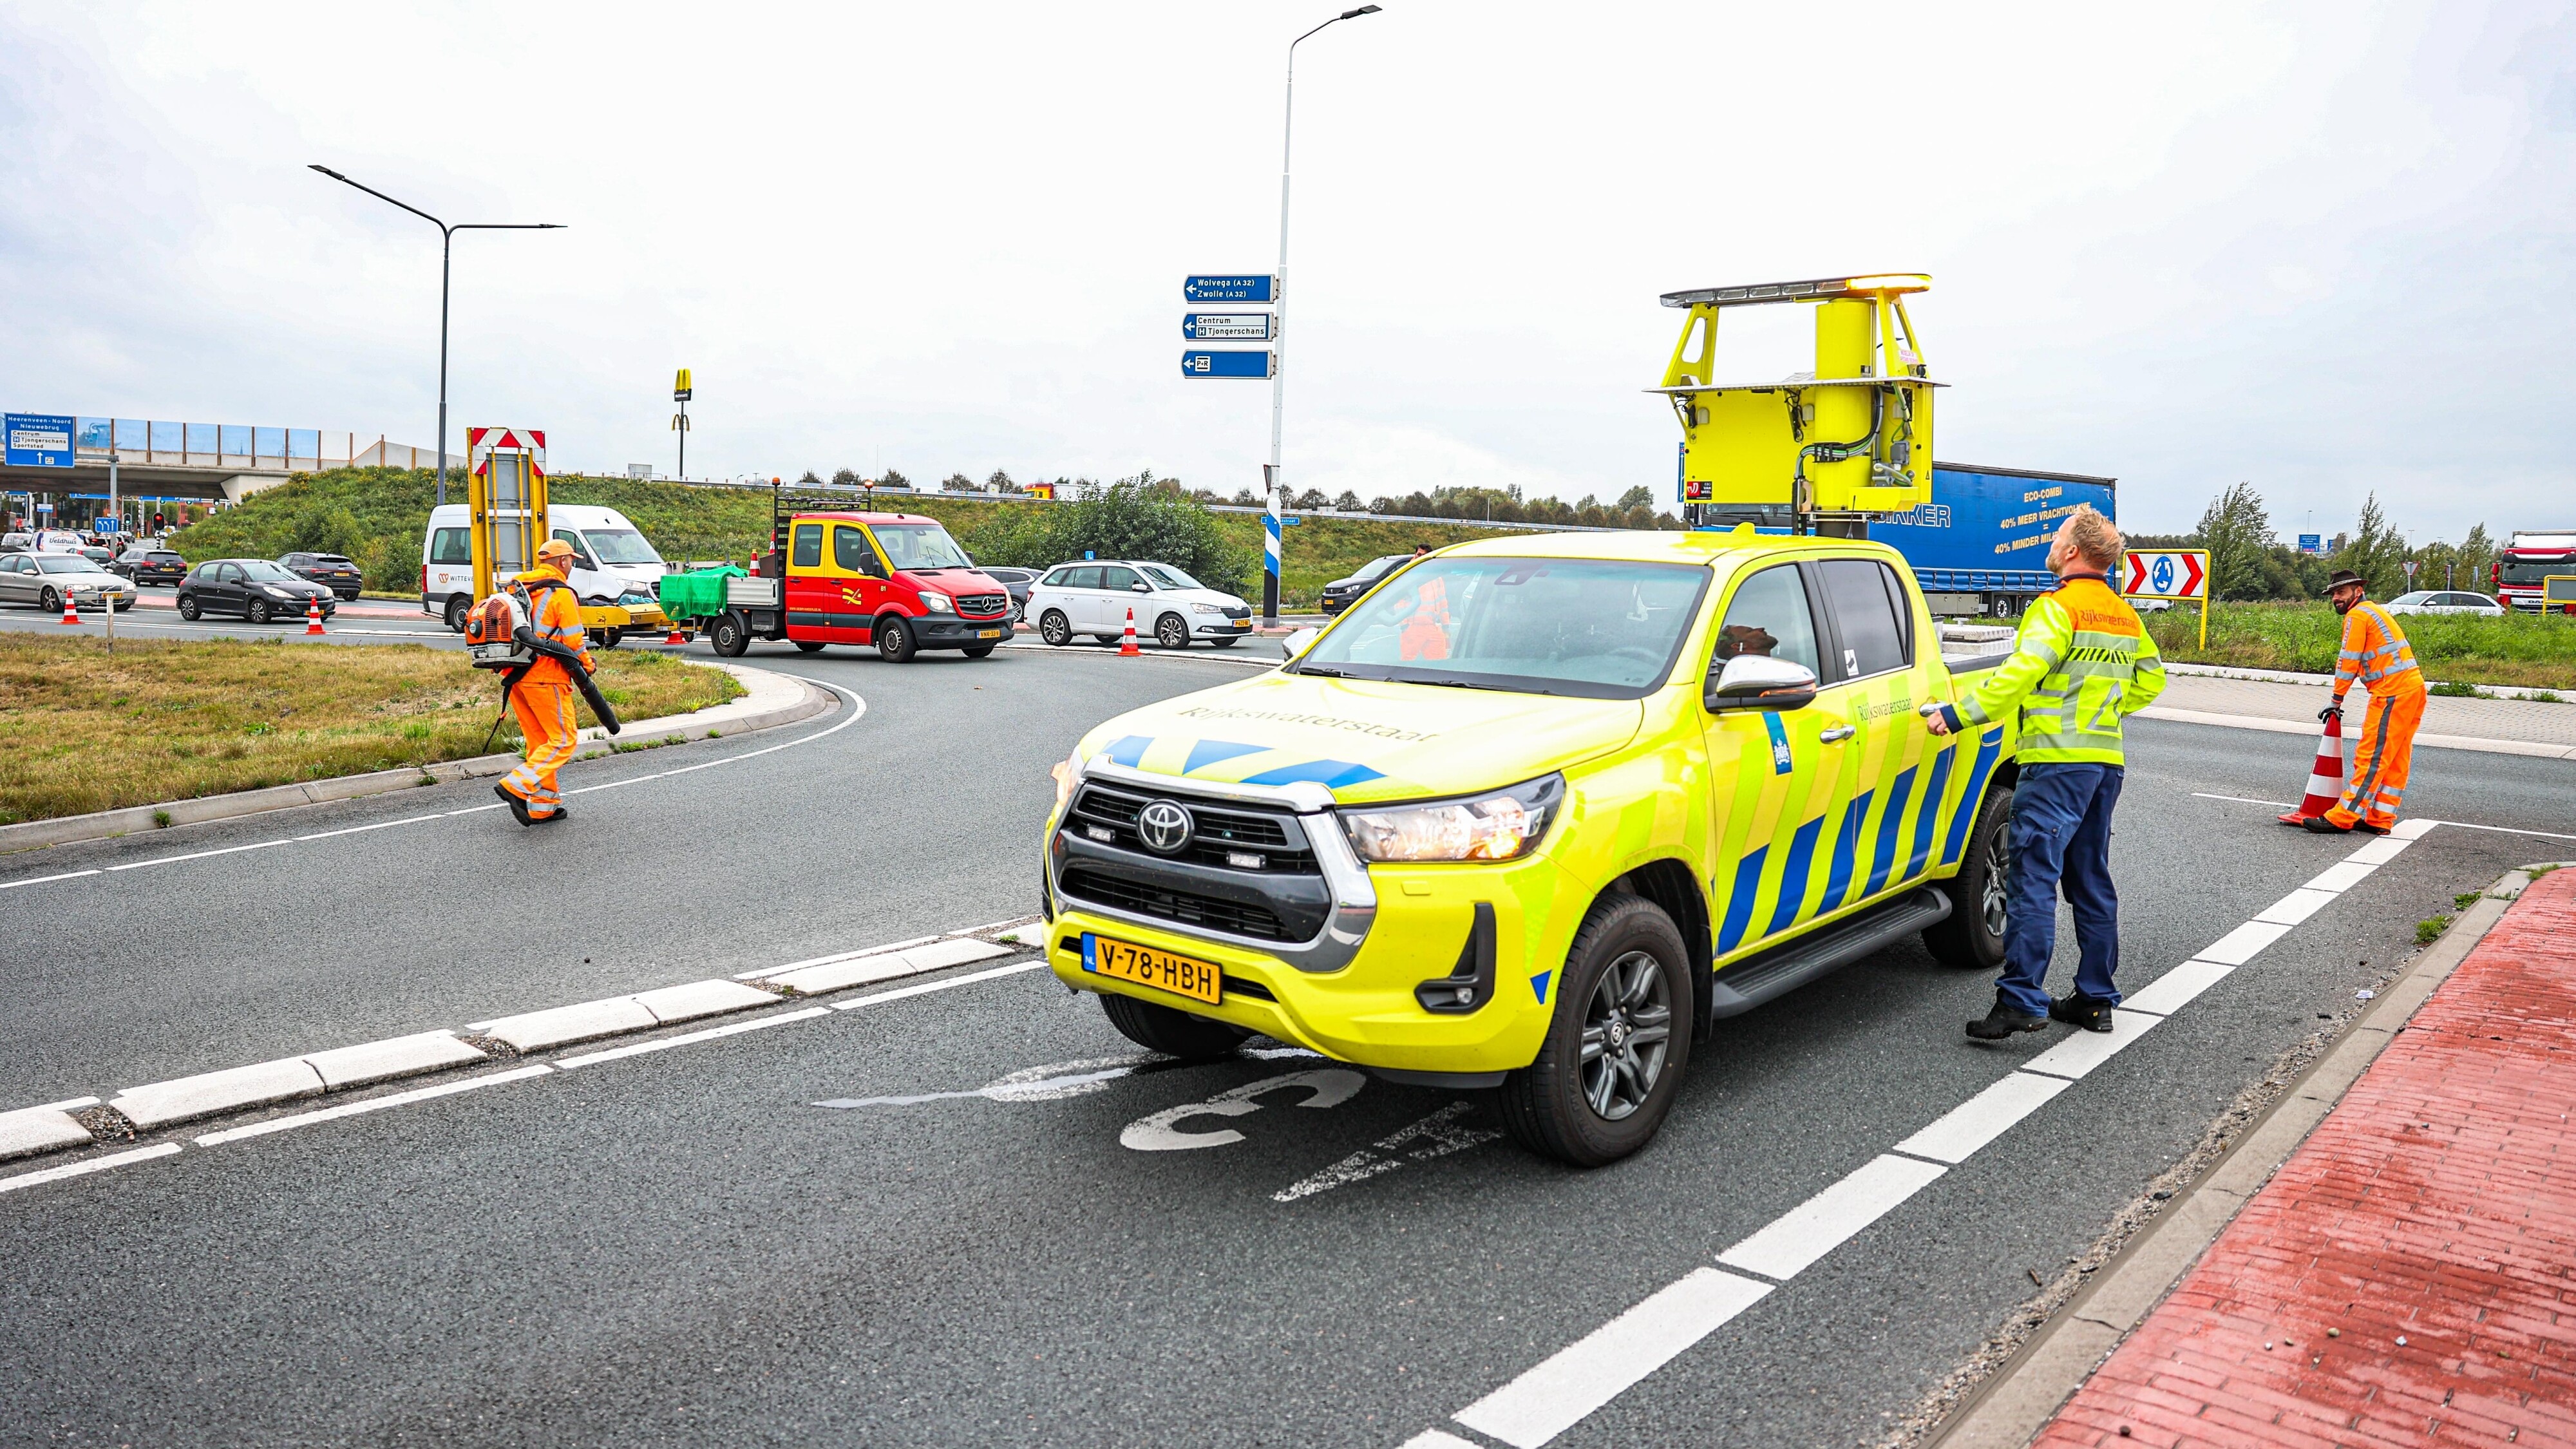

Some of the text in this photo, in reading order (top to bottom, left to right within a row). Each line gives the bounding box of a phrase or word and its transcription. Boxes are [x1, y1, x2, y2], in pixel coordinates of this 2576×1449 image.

[1198, 279, 1231, 288] Wolvega
[1208, 328, 1264, 336] Tjongerschans
[2024, 486, 2062, 502] ECO-COMBI
[2000, 517, 2016, 529] 40%
[2018, 513, 2038, 526] MEER
[1994, 542, 2011, 554] 40%
[2012, 535, 2039, 551] MINDER
[1857, 697, 1913, 724] Rijkswaterstaat
[1179, 706, 1441, 742] Rijkswaterstaat
[1085, 943, 1211, 996] NL V-78-HBH
